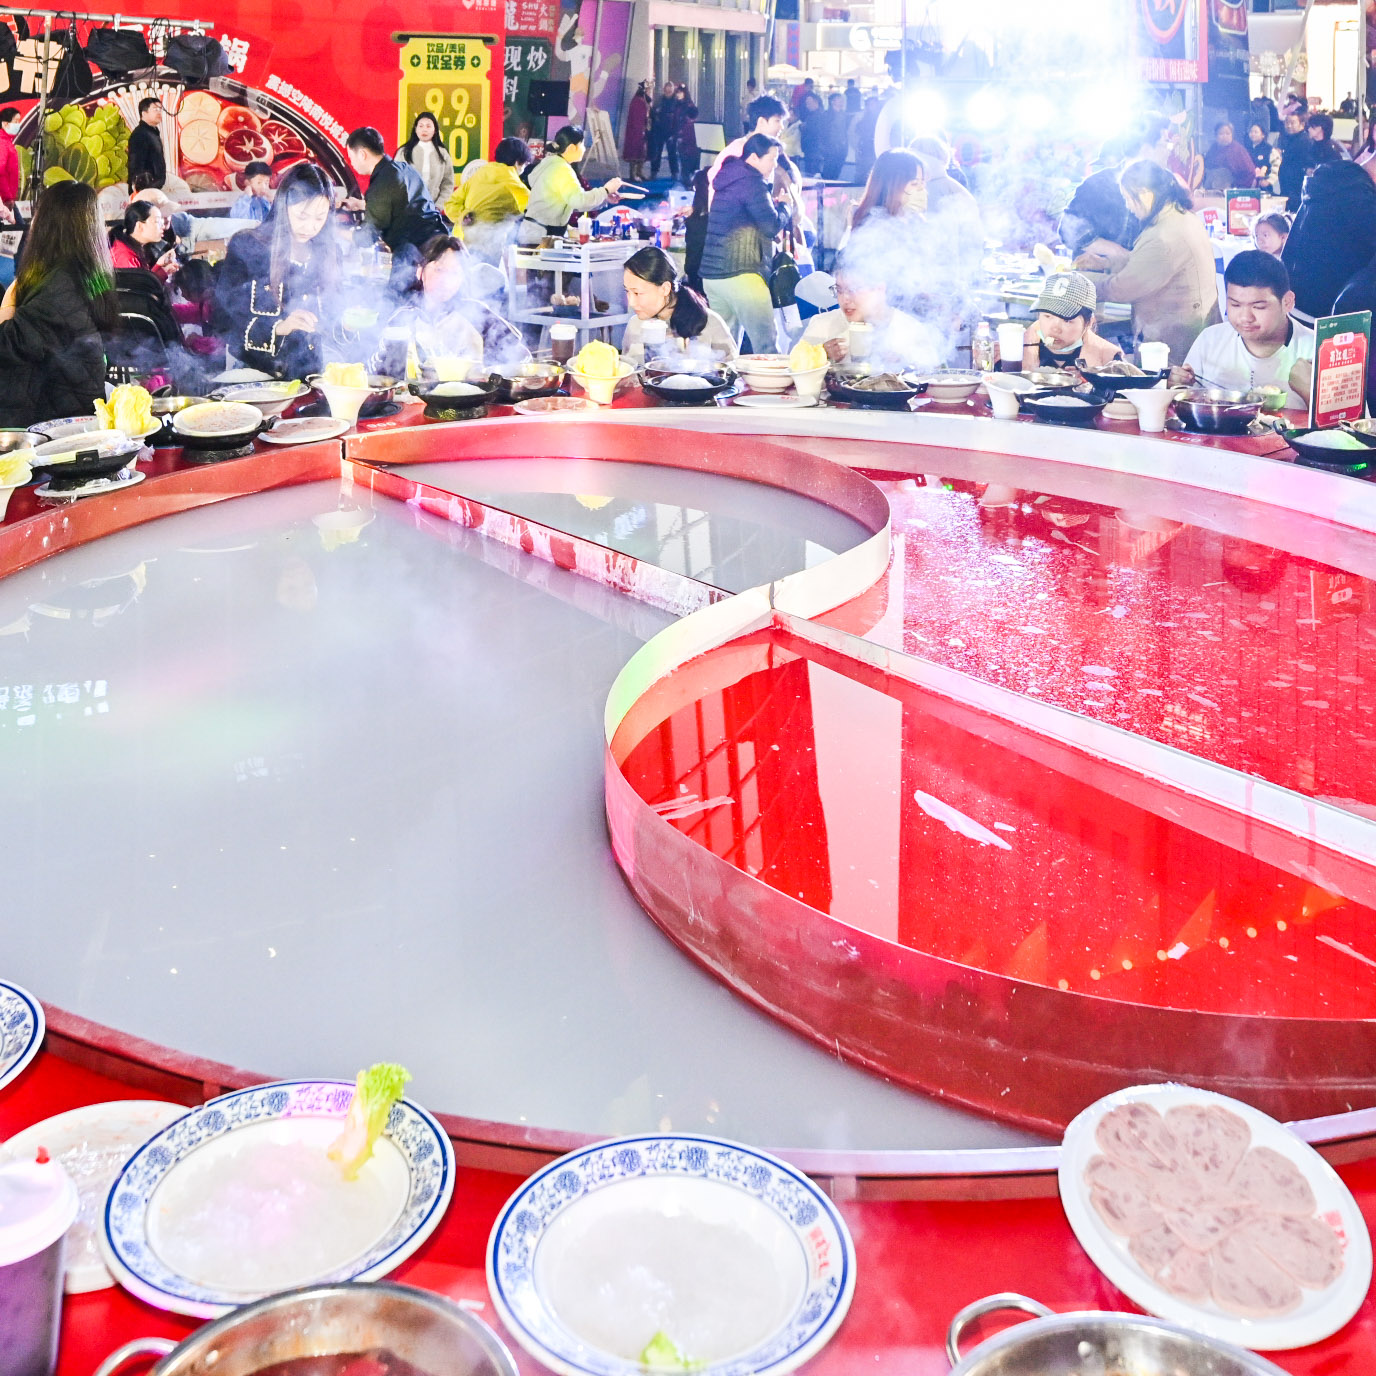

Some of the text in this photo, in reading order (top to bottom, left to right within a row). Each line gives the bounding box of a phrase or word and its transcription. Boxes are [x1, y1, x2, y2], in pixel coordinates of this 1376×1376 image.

[427, 43, 466, 55] 饮品/美食
[426, 54, 466, 71] 现金券
